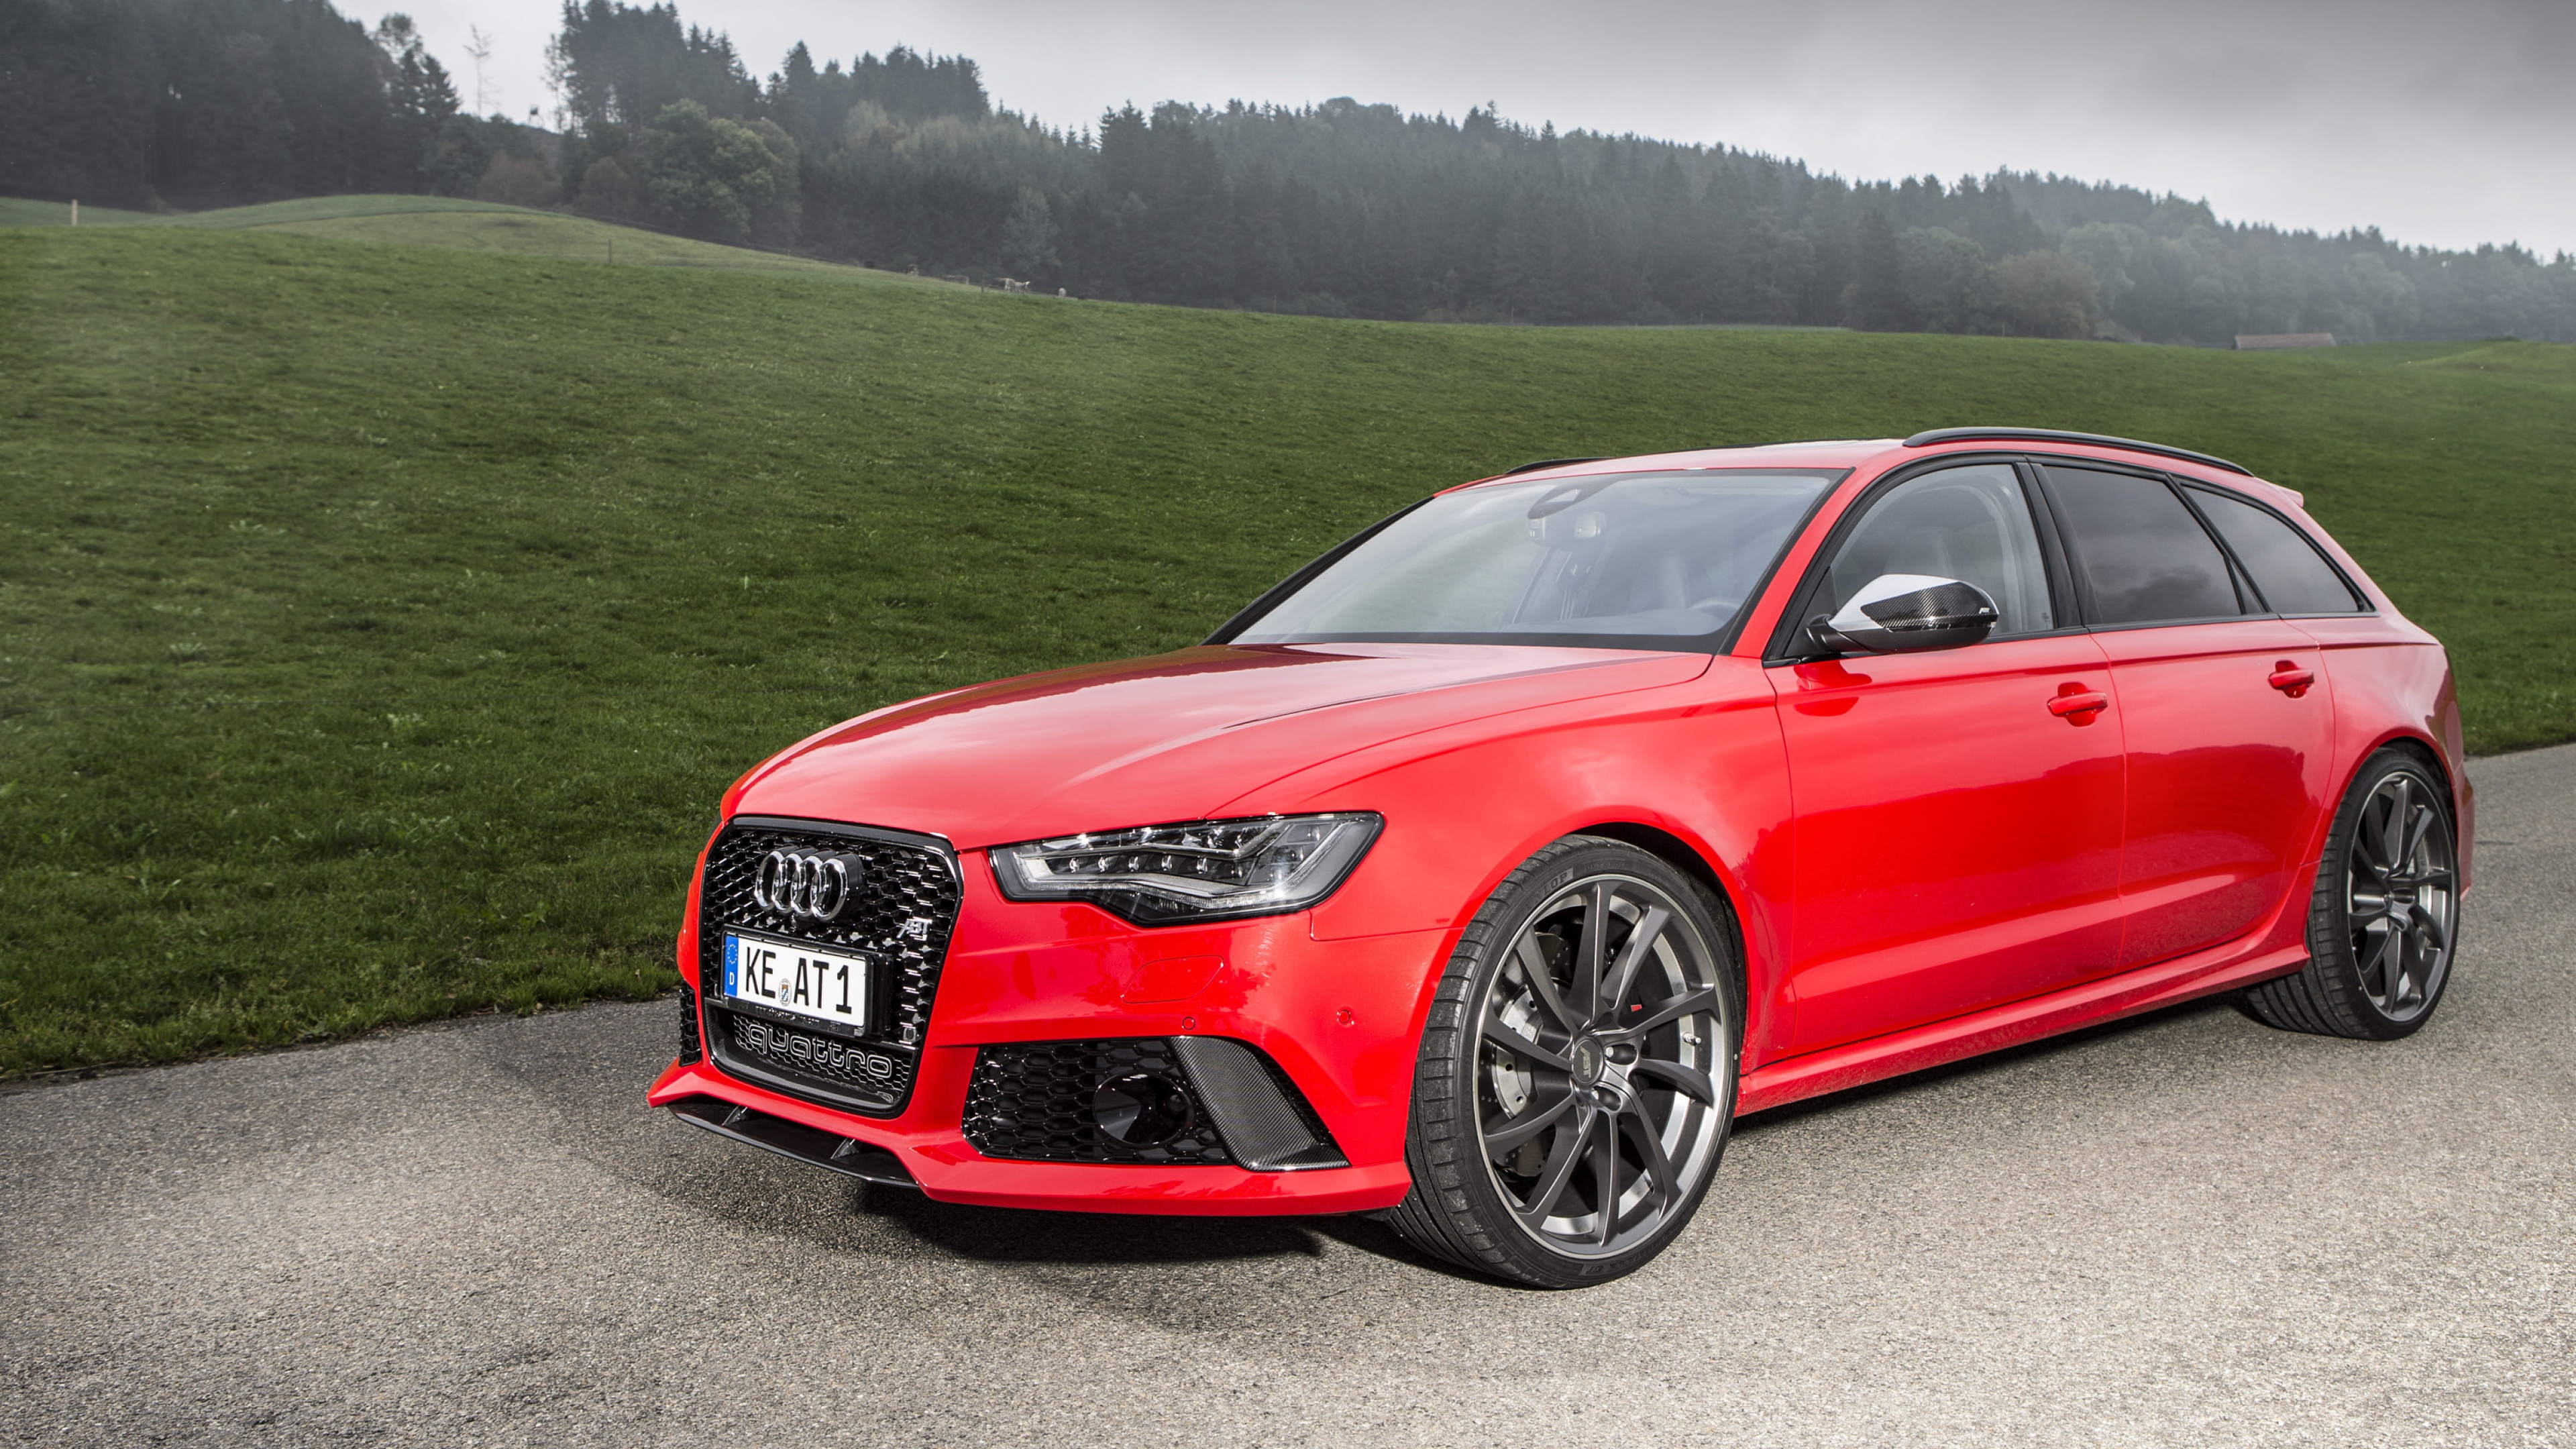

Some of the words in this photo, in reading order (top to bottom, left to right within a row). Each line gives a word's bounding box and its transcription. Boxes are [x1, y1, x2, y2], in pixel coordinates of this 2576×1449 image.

[896, 916, 932, 941] ABT
[729, 971, 735, 985] D
[745, 947, 776, 999] KE
[748, 1024, 892, 1078] quattro
